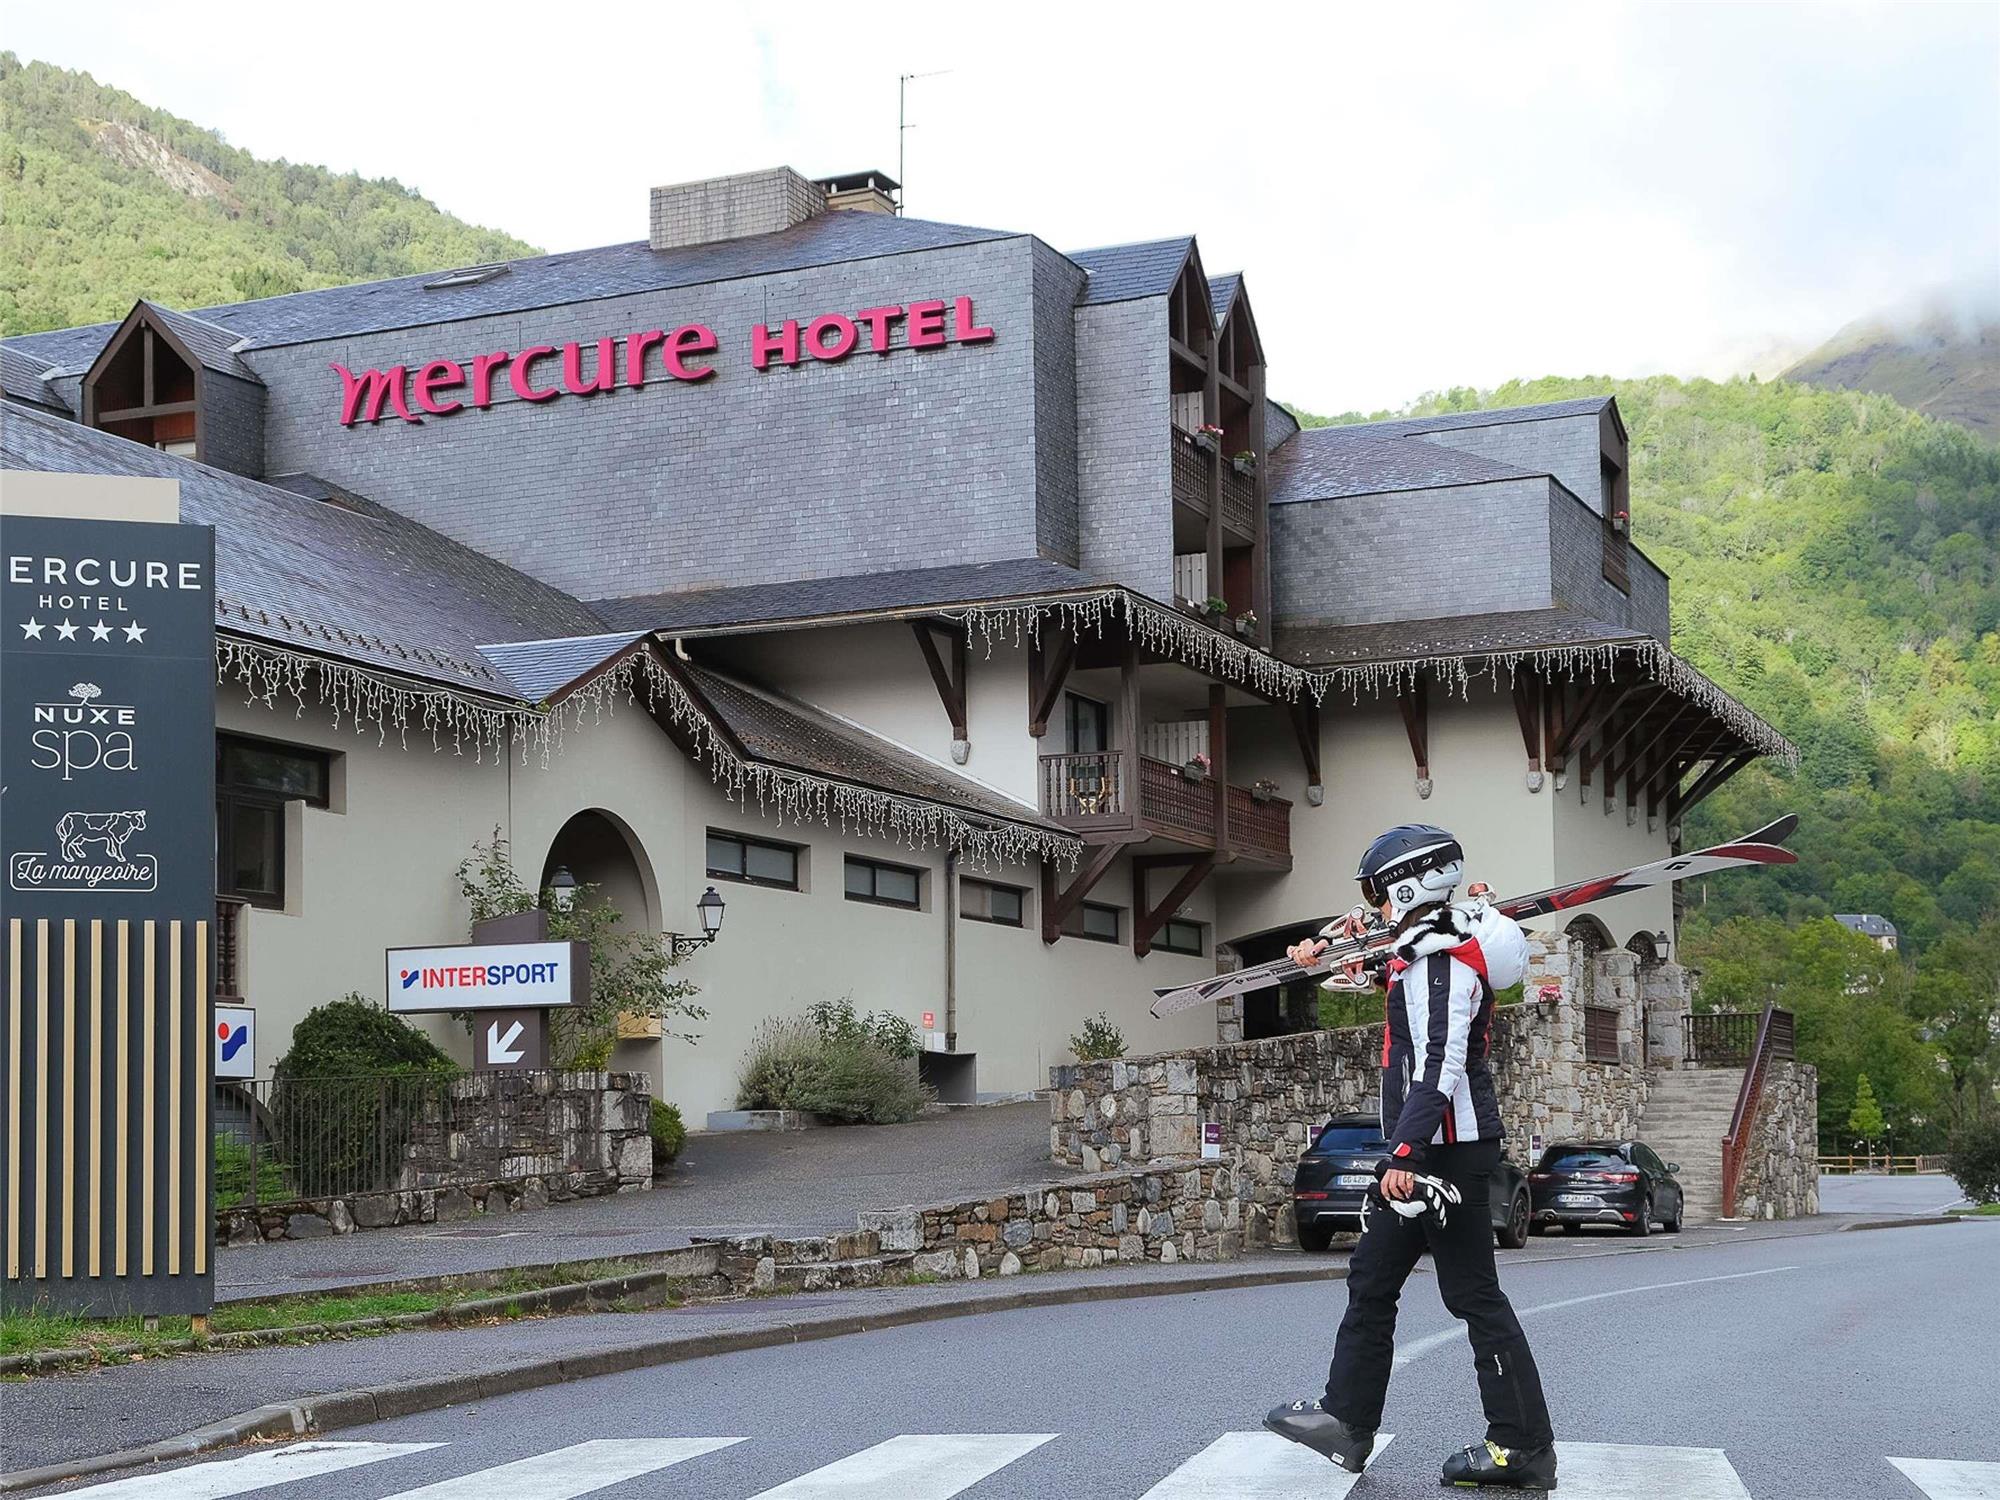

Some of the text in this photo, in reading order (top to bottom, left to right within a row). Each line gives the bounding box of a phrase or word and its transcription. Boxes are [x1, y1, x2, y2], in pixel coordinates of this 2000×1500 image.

[329, 296, 993, 425] mercure HOTEL
[9, 556, 202, 590] ERCURE
[39, 594, 128, 611] HOTEL
[34, 706, 136, 726] NUXE
[31, 729, 138, 781] spa
[17, 856, 153, 888] La mangeoire
[1380, 868, 1405, 884] JULBO
[422, 962, 558, 988] INTERSPORT
[1245, 972, 1271, 982] Black
